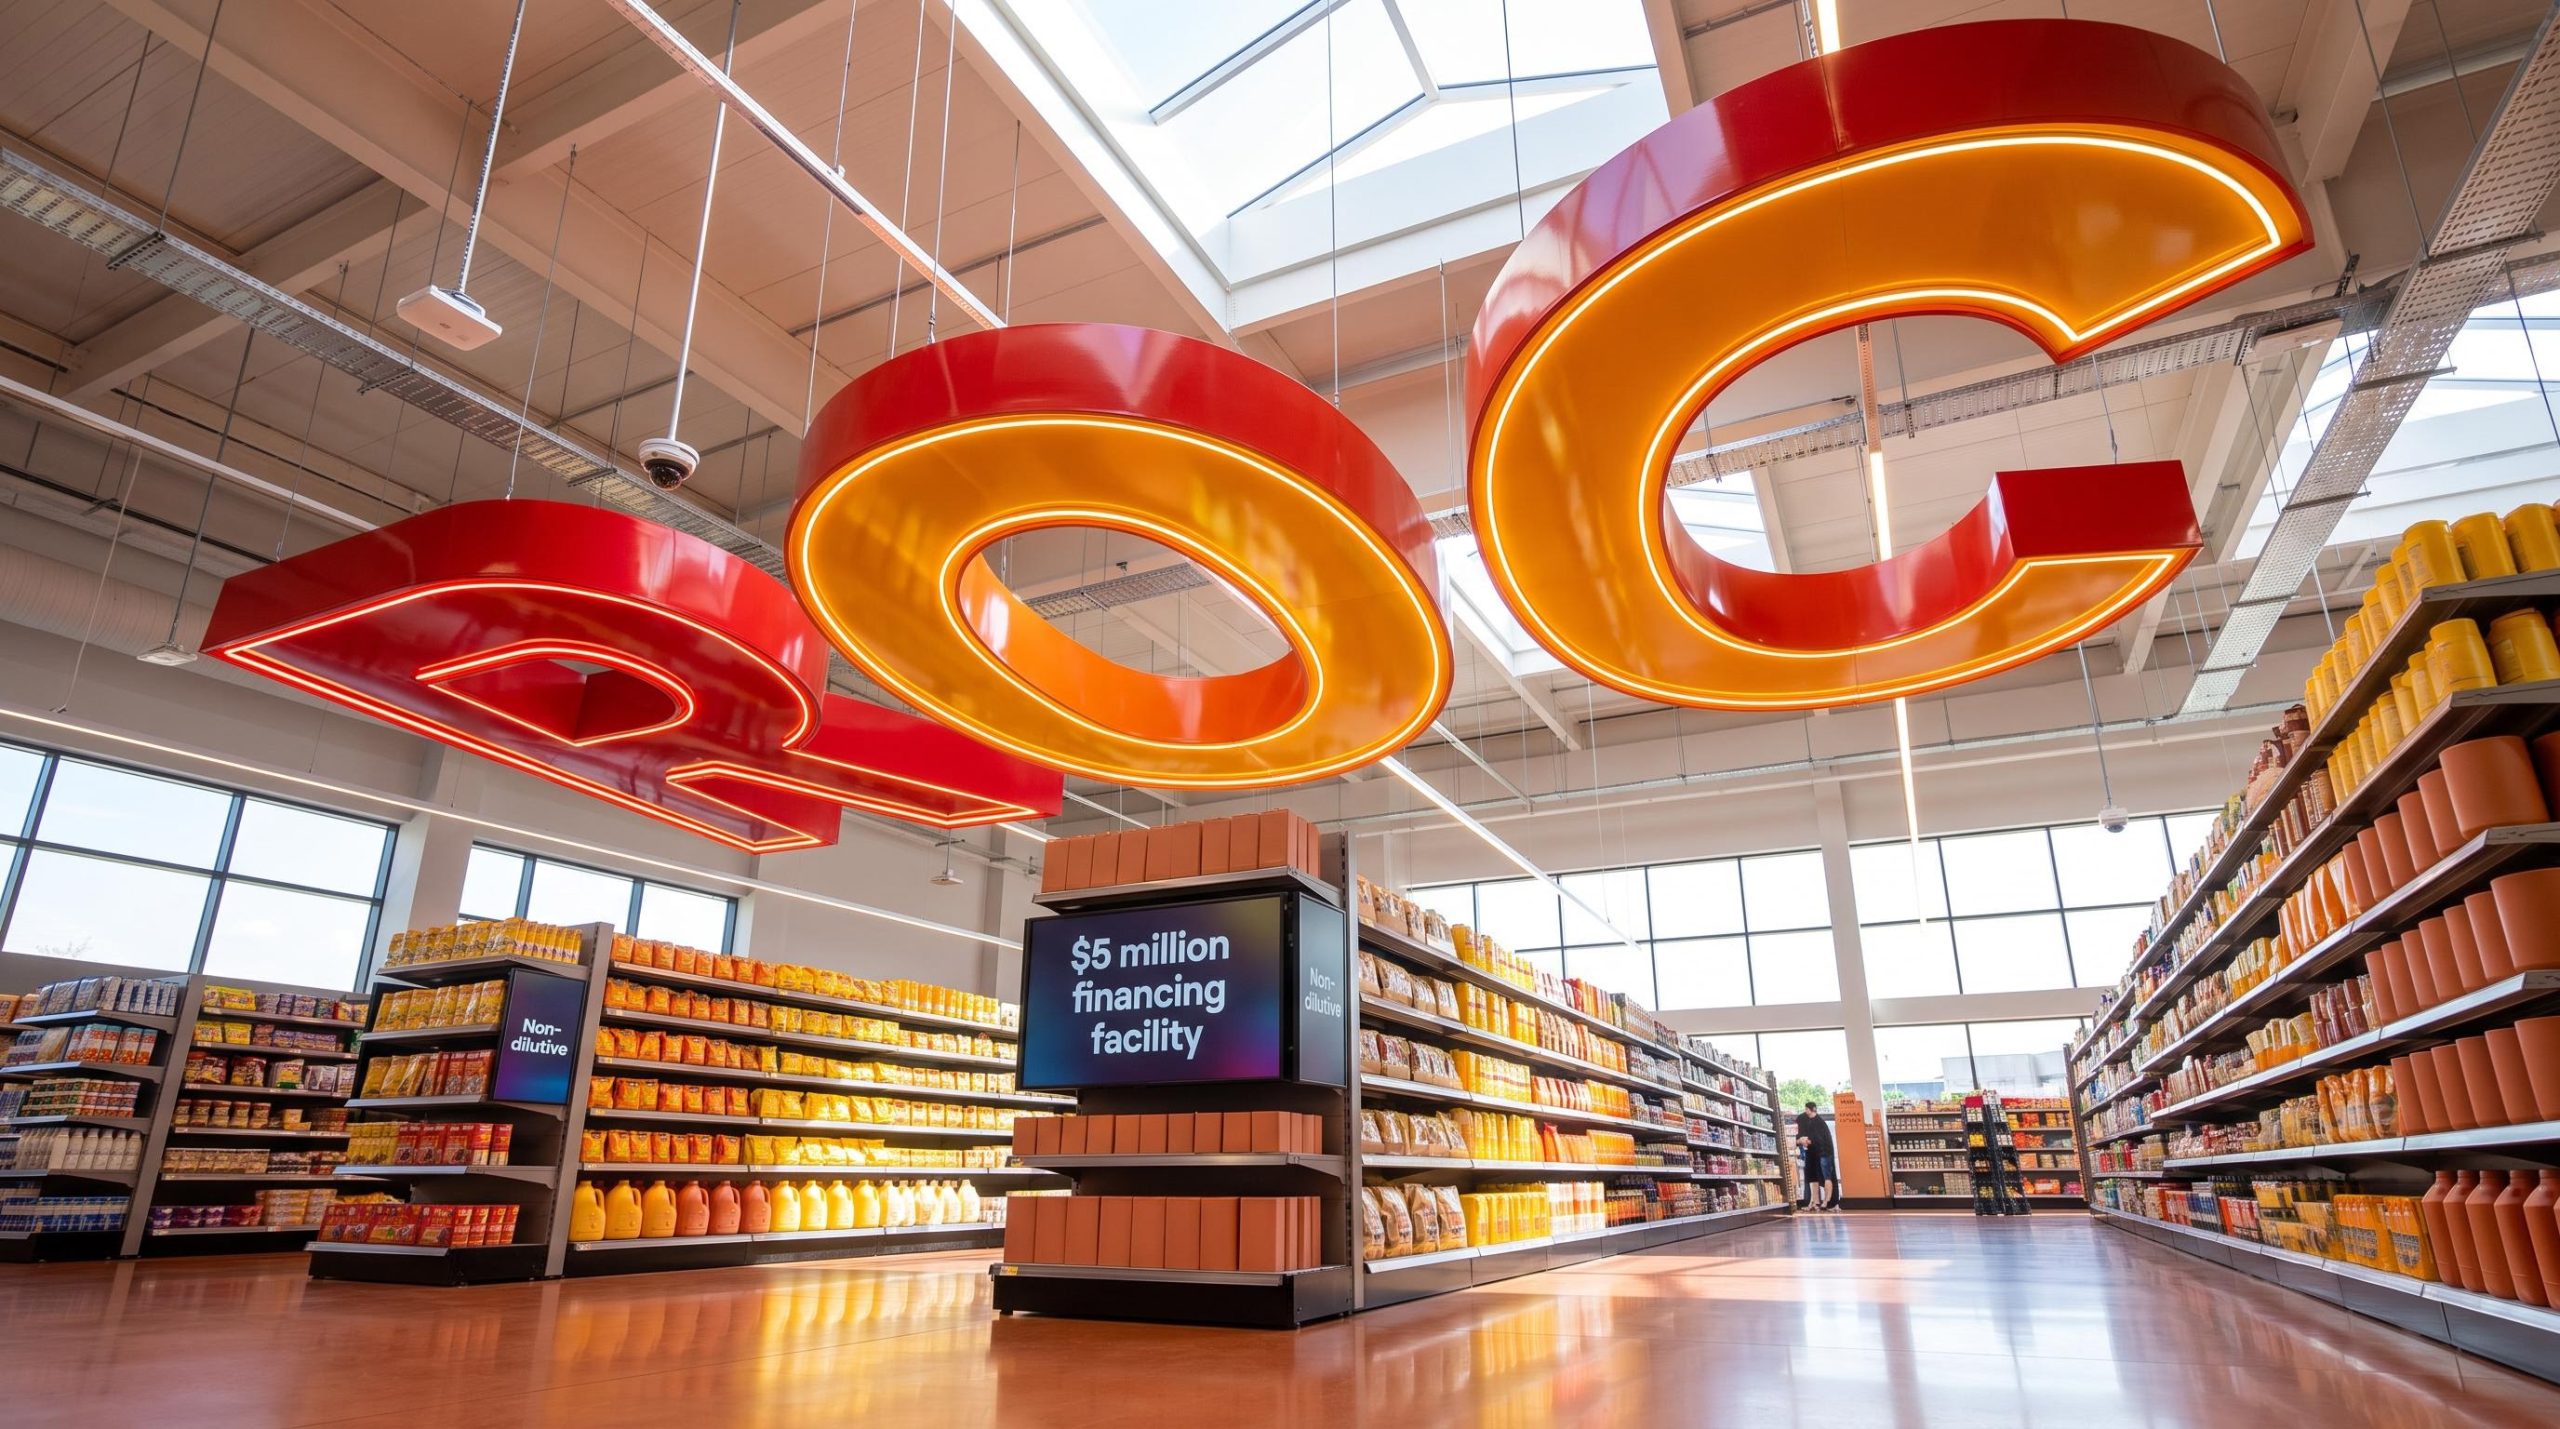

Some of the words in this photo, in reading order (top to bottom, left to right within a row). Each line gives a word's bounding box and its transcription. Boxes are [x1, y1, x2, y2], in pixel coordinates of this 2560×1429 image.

[1070, 935, 1112, 976] $5
[1120, 929, 1230, 968] million
[1309, 966, 1337, 991] Non-
[1072, 973, 1226, 1014] financing
[1304, 993, 1343, 1018] dilutive
[522, 1018, 562, 1036] Non-
[1090, 1017, 1204, 1060] facility
[510, 1035, 568, 1056] dilutive
